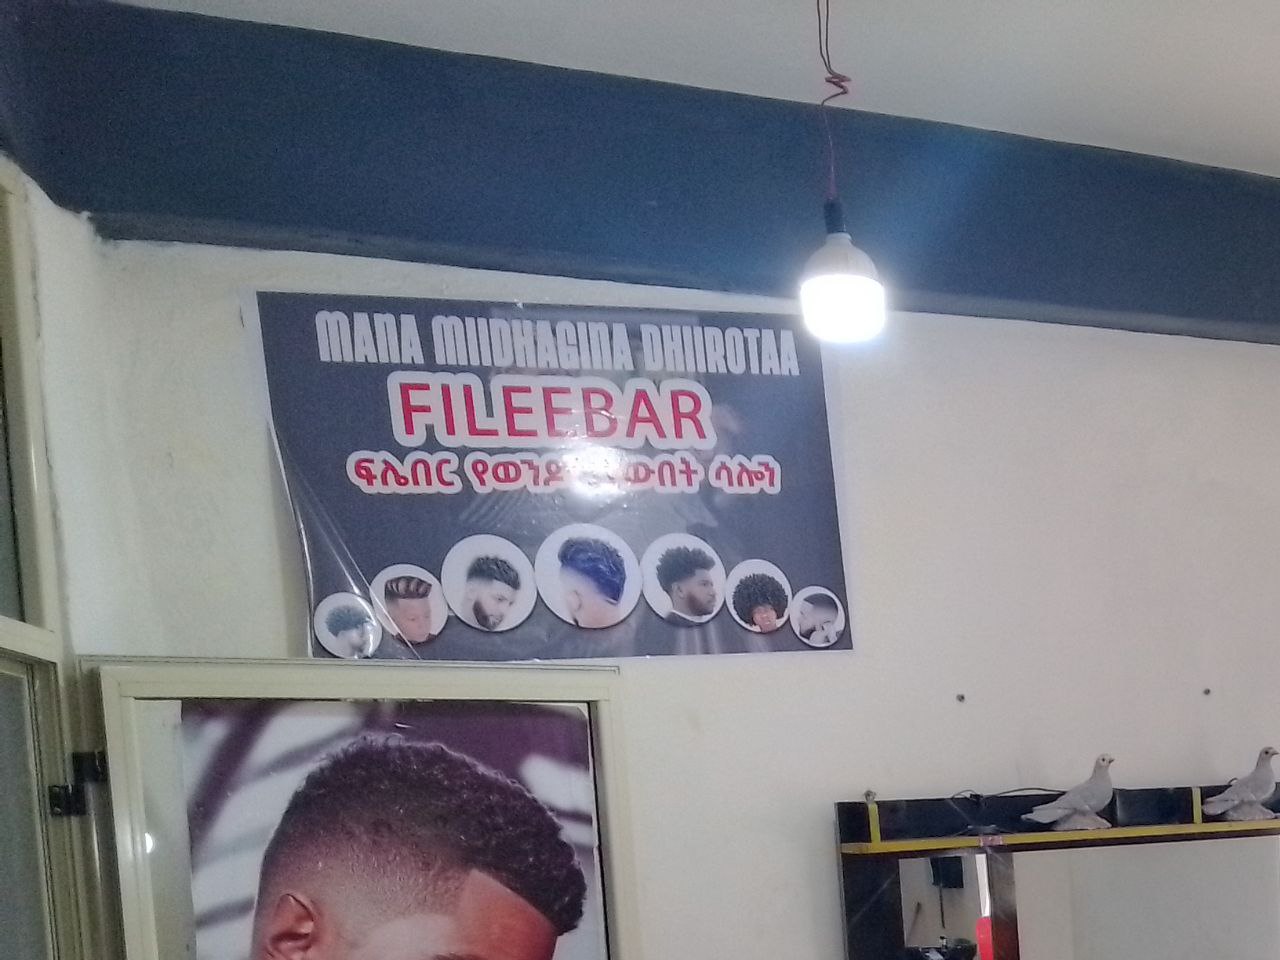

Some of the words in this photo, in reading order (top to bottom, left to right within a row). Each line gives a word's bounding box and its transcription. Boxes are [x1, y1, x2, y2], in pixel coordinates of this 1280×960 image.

[398, 381, 708, 441] FILEEBAR
[471, 458, 587, 486] የወንዶ
[598, 456, 698, 488] ውበት
